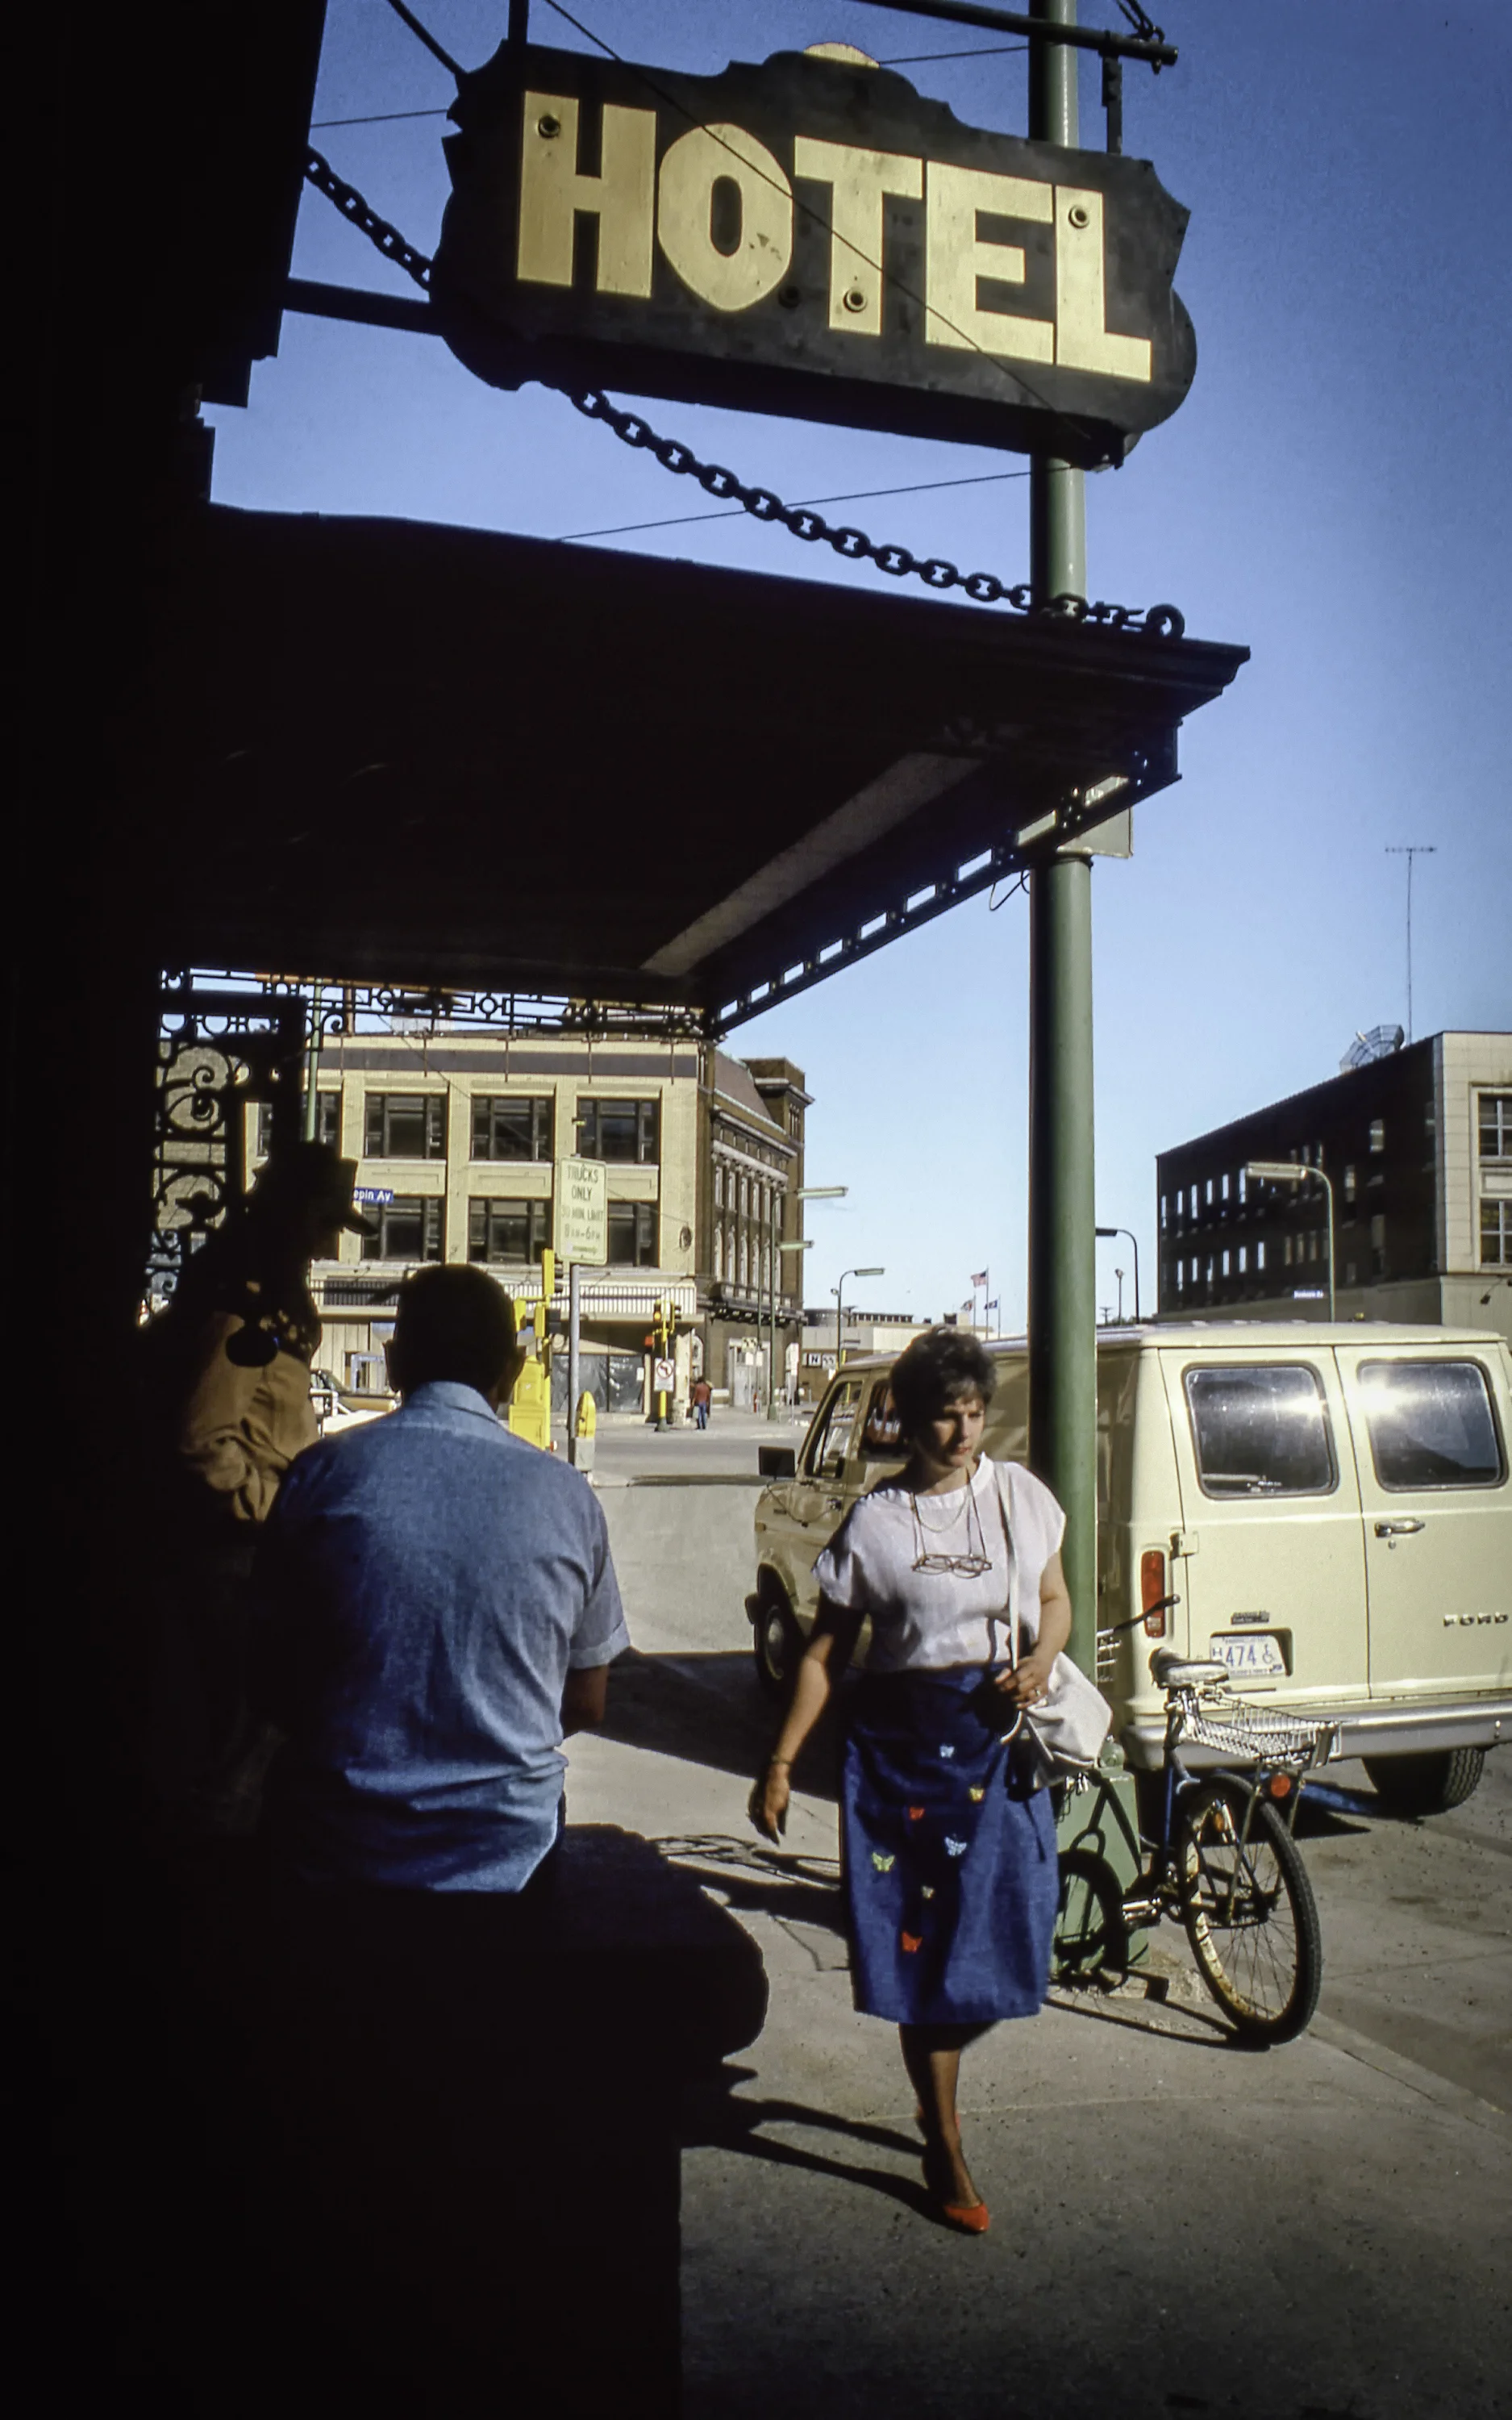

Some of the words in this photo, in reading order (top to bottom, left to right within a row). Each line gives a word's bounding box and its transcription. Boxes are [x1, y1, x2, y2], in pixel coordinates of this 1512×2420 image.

[517, 89, 1152, 383] HOTEL
[567, 1165, 598, 1183] TRUCKS
[571, 1184, 592, 1201] ONLY
[1443, 1612, 1509, 1627] FORD
